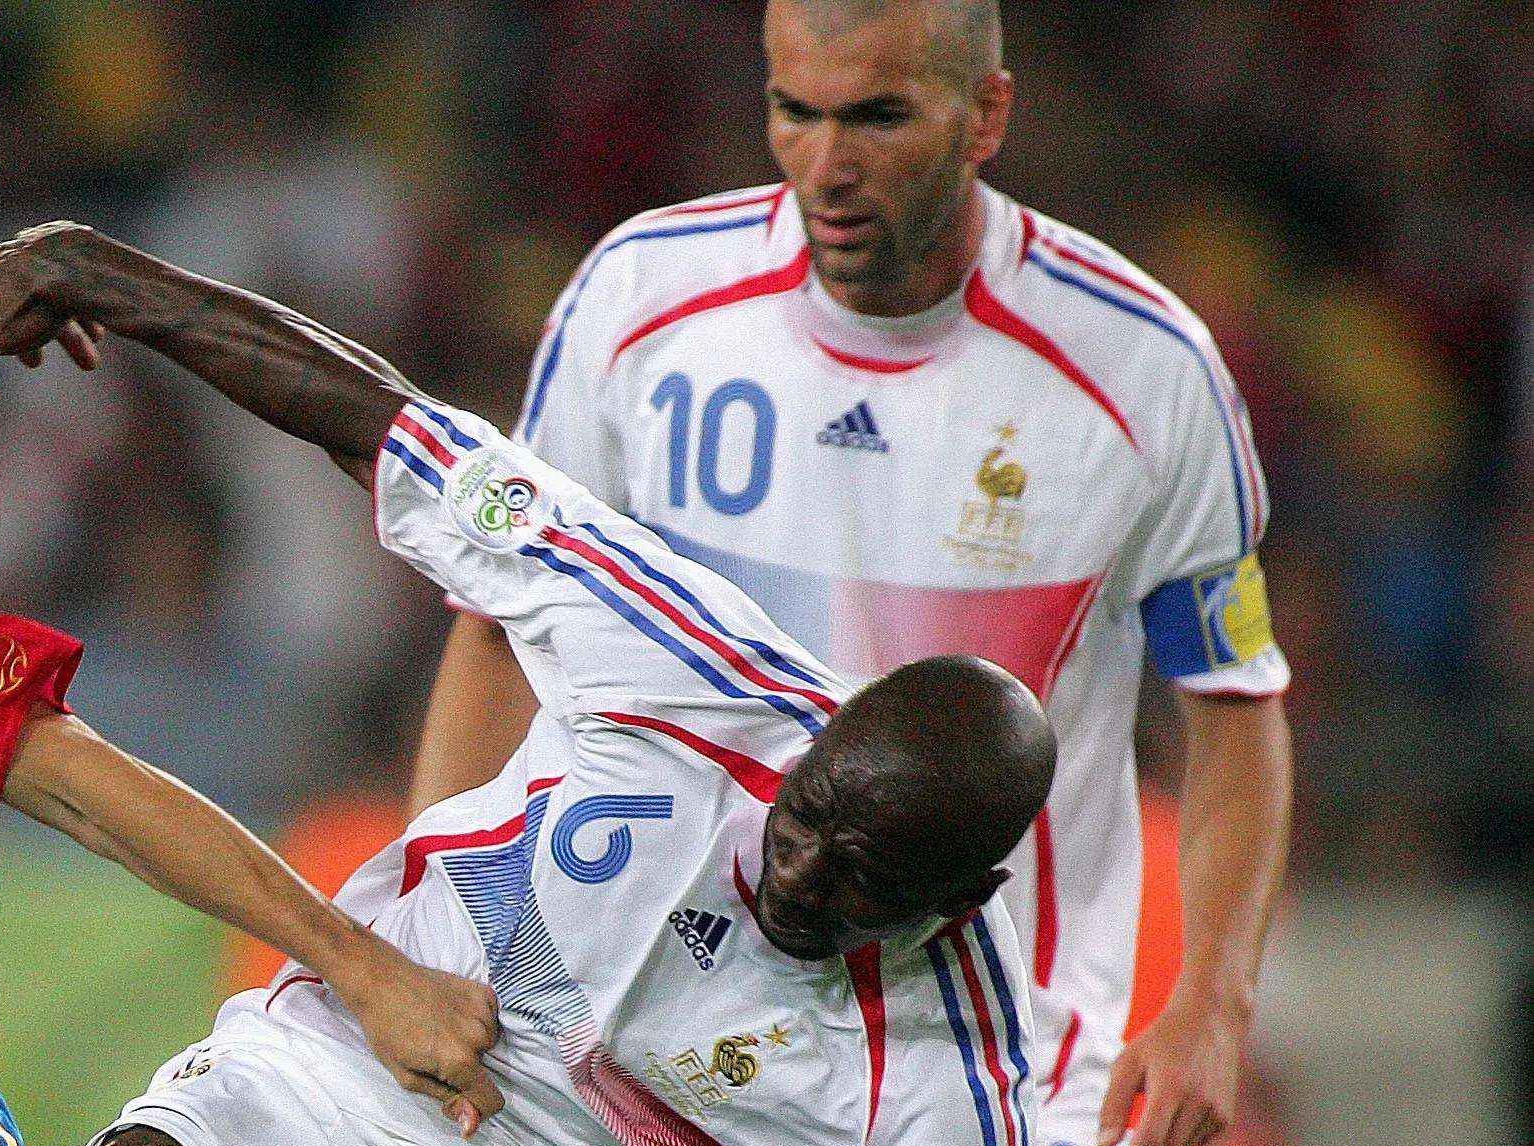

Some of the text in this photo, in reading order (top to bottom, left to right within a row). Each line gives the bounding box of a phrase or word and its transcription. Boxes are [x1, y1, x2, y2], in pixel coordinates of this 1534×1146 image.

[650, 372, 777, 516] 10
[551, 794, 674, 885] 6
[668, 910, 714, 971] adidas
